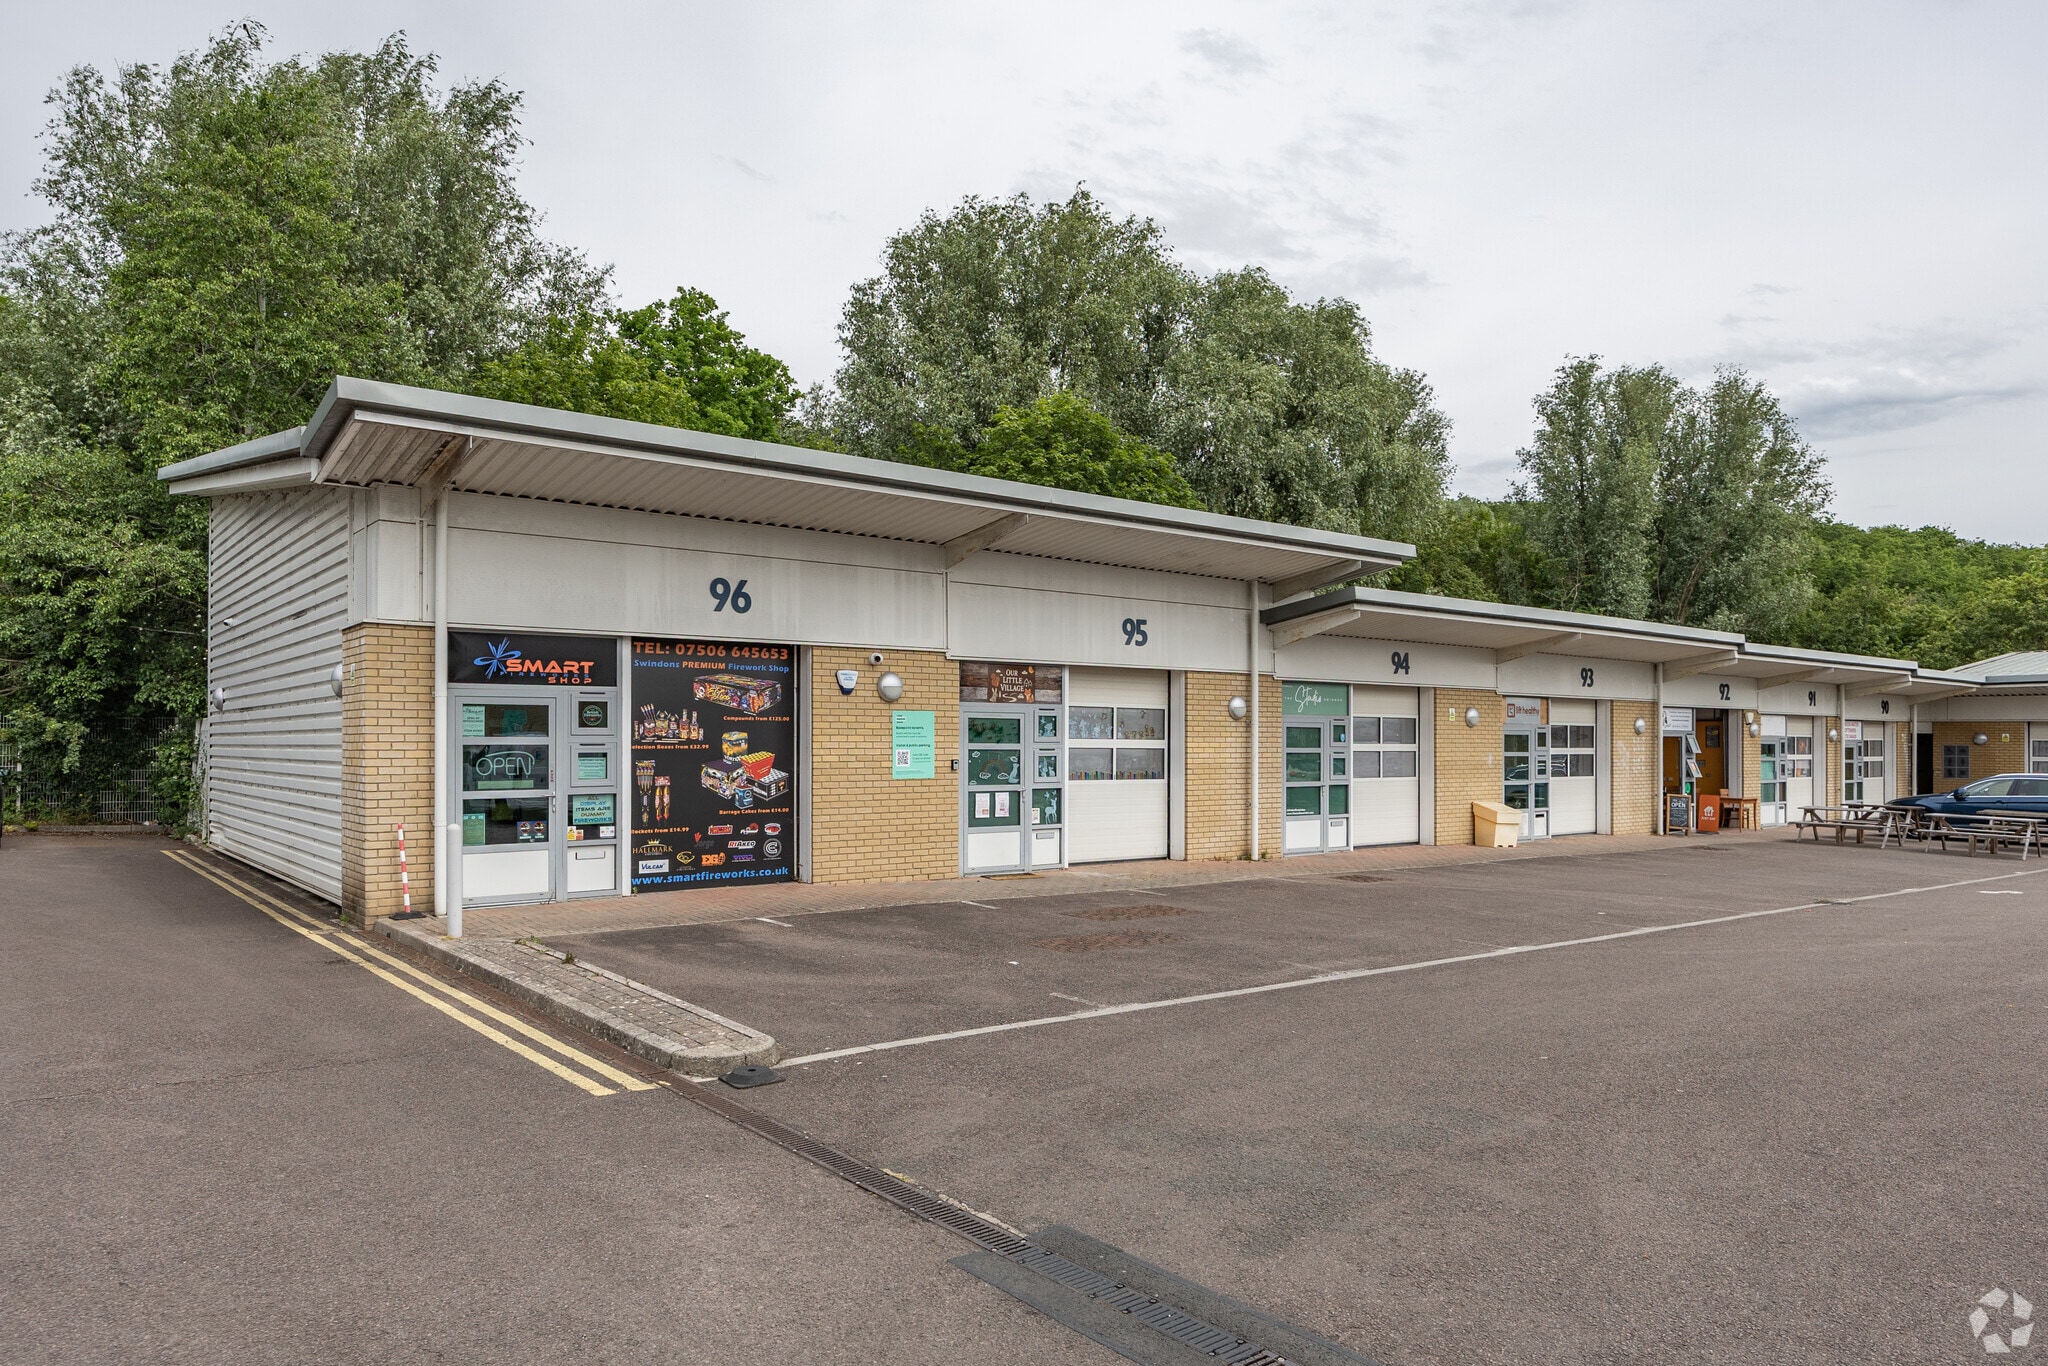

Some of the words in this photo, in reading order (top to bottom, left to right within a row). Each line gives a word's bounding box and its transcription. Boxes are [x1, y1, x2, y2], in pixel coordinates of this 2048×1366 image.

[710, 577, 752, 614] 96
[1122, 618, 1148, 647] 95
[633, 641, 670, 655] TEL:
[675, 643, 726, 657] 07506
[731, 646, 788, 660] 645653
[506, 659, 595, 674] SMART
[633, 659, 680, 668] Swindons
[682, 661, 726, 669] PREMIUM
[728, 663, 767, 671] Firework
[768, 664, 790, 674] Shop
[1391, 651, 1410, 675] 94
[548, 677, 592, 685] SHOP
[1002, 676, 1023, 684] LITTLE
[1580, 667, 1594, 687] 93
[1000, 683, 1025, 692] VILLAGE
[1719, 683, 1730, 700] 92
[1295, 685, 1321, 713] Studio
[1808, 691, 1816, 706] 91
[1880, 700, 1889, 714] 90
[475, 757, 532, 776] OPEN
[632, 846, 673, 854] HALLMARK
[631, 866, 789, 885] www.smartfireworks.co.uk
